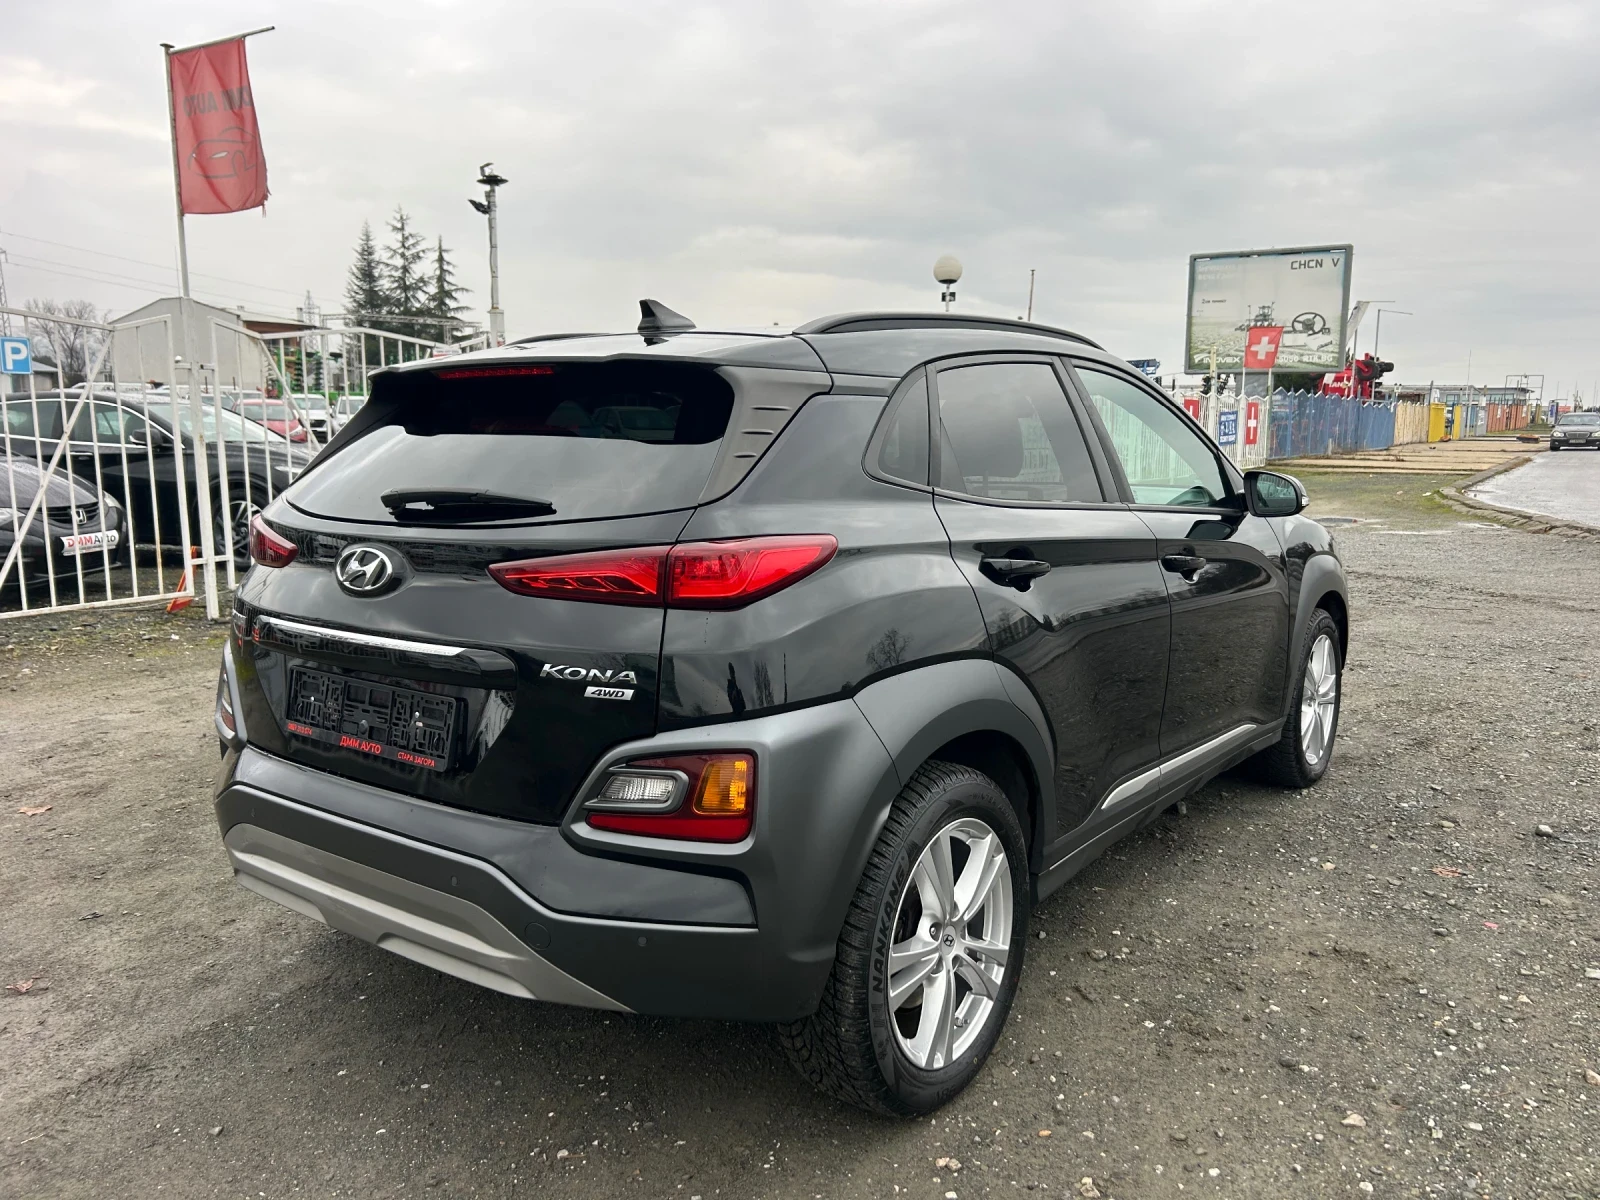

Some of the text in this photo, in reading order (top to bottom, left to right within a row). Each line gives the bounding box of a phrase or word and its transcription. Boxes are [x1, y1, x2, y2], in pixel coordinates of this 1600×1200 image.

[4, 341, 28, 370] P
[539, 663, 637, 684] KONA
[590, 688, 625, 699] 4WD
[339, 735, 381, 754] ДММ АУТО
[397, 751, 436, 768] СТАРА ЗАГОРА
[872, 864, 907, 994] NANKANG
